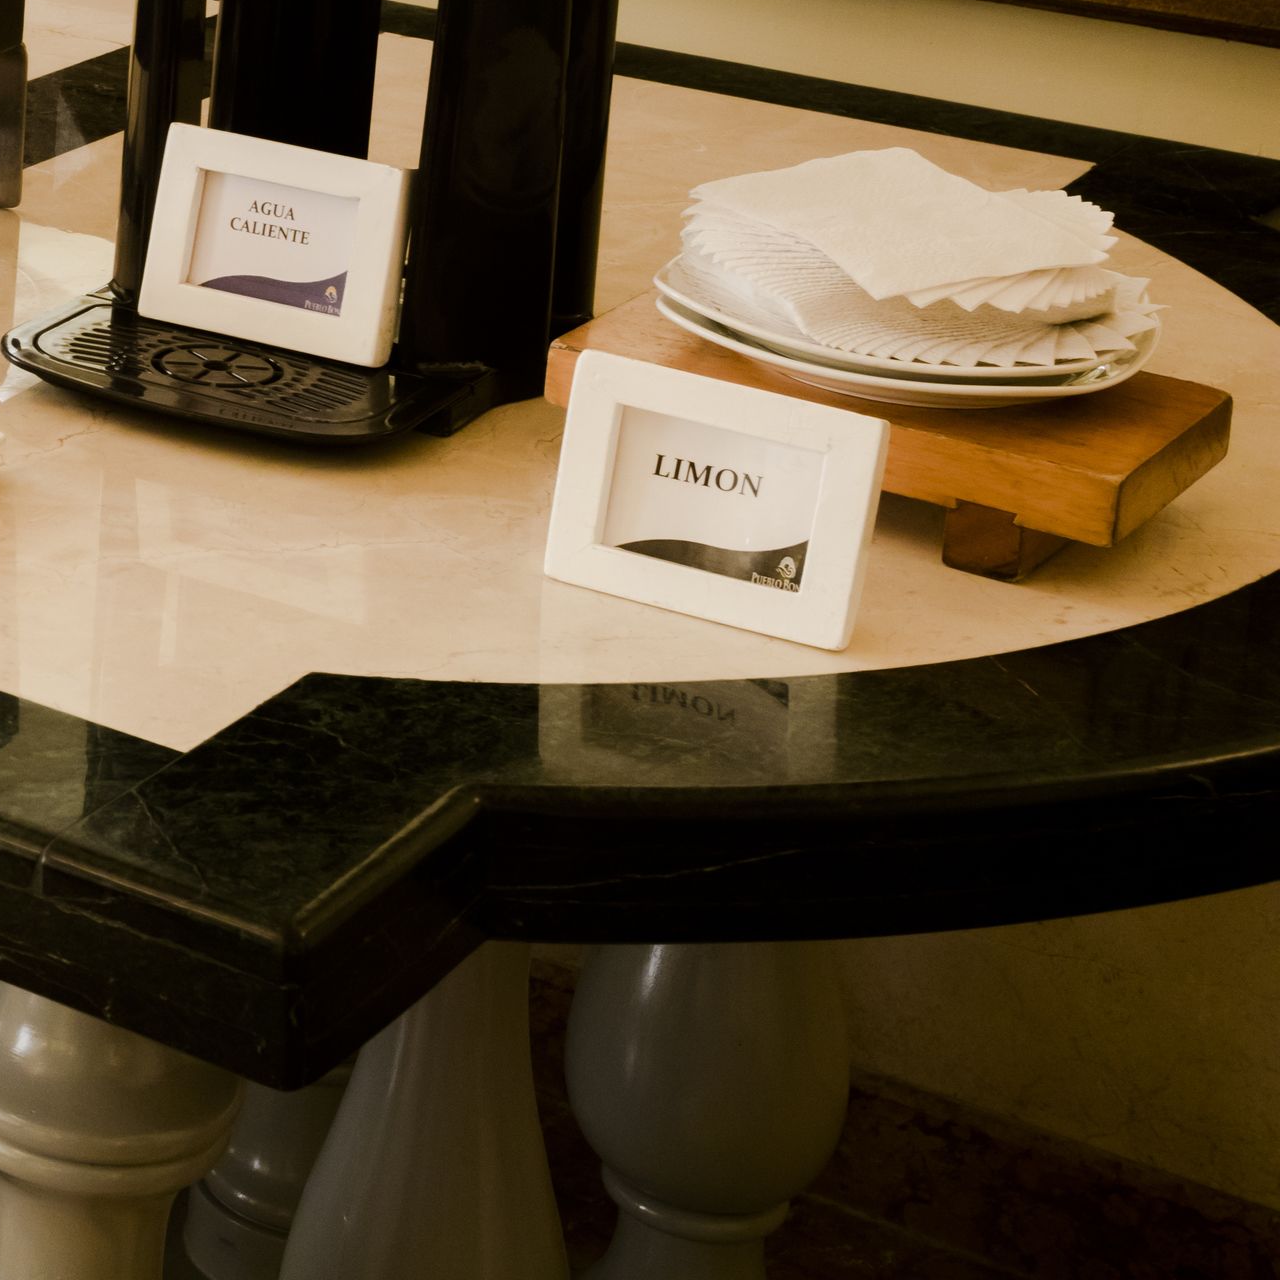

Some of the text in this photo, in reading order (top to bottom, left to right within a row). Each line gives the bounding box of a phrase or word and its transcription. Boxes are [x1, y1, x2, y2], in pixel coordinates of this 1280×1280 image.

[248, 200, 295, 221] AGUA
[229, 216, 310, 245] CALIENTE
[652, 453, 764, 498] LIMON
